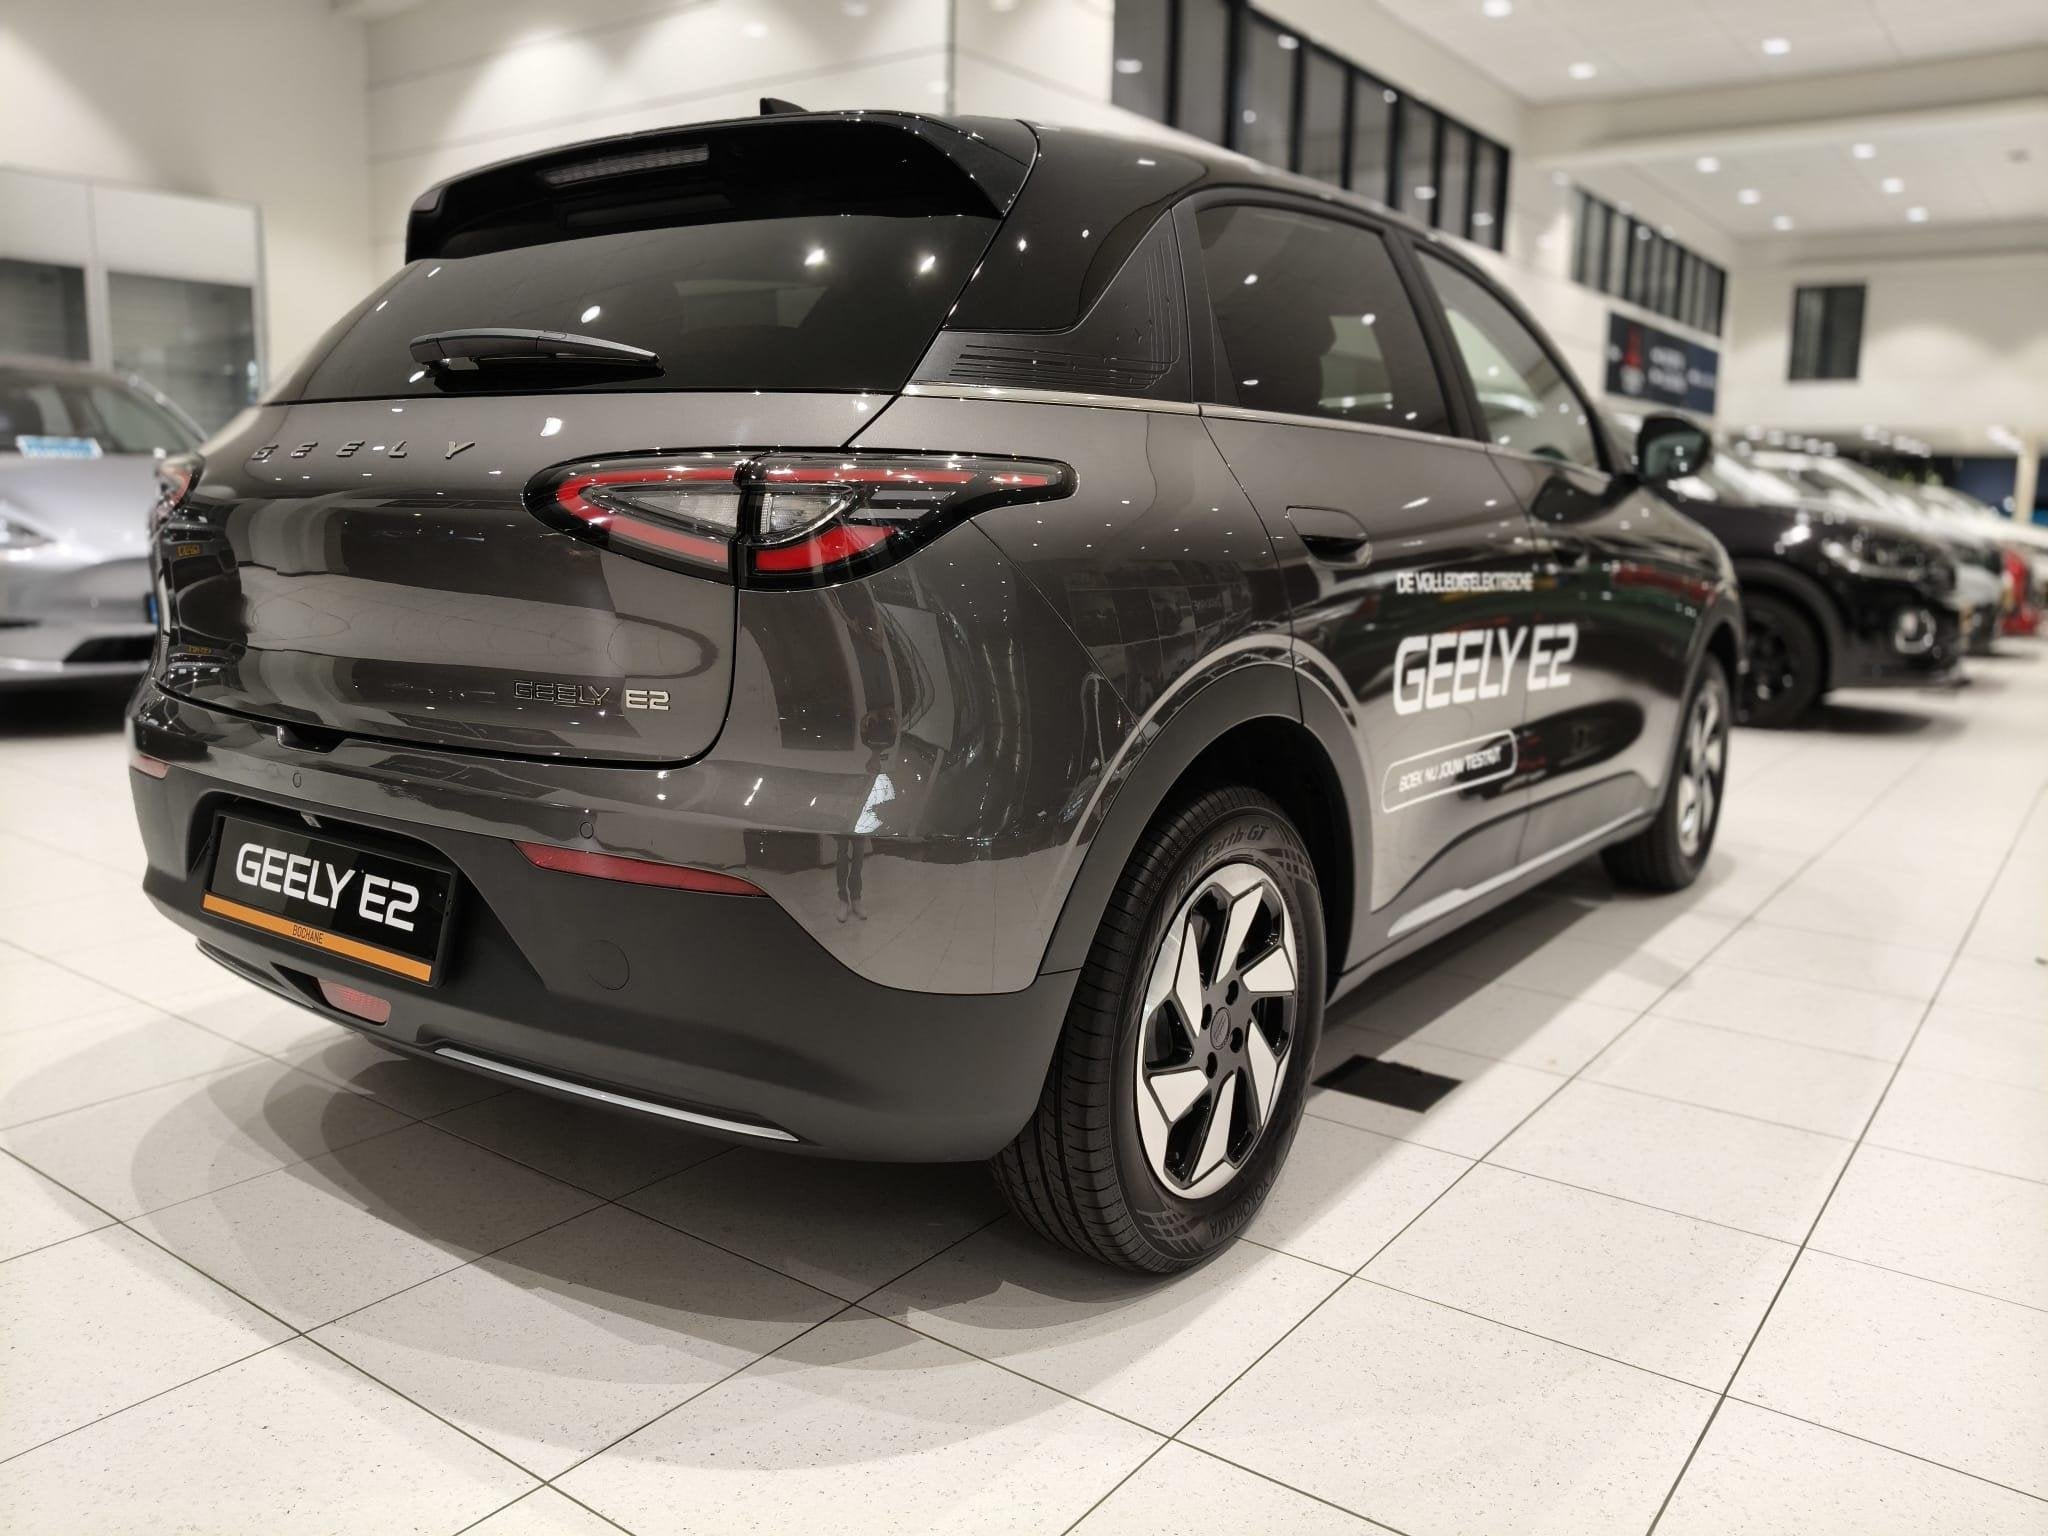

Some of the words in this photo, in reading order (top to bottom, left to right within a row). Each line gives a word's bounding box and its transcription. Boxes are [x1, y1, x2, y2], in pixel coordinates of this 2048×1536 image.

[251, 441, 476, 460] GEELY
[1396, 572, 1415, 594] DE
[1393, 625, 1529, 716] GEELY
[1527, 622, 1579, 692] E2
[513, 680, 611, 706] GEELY
[625, 689, 671, 711] E2
[235, 842, 356, 909] GEELY
[358, 873, 420, 932] E2
[292, 924, 325, 945] BOCHANE
